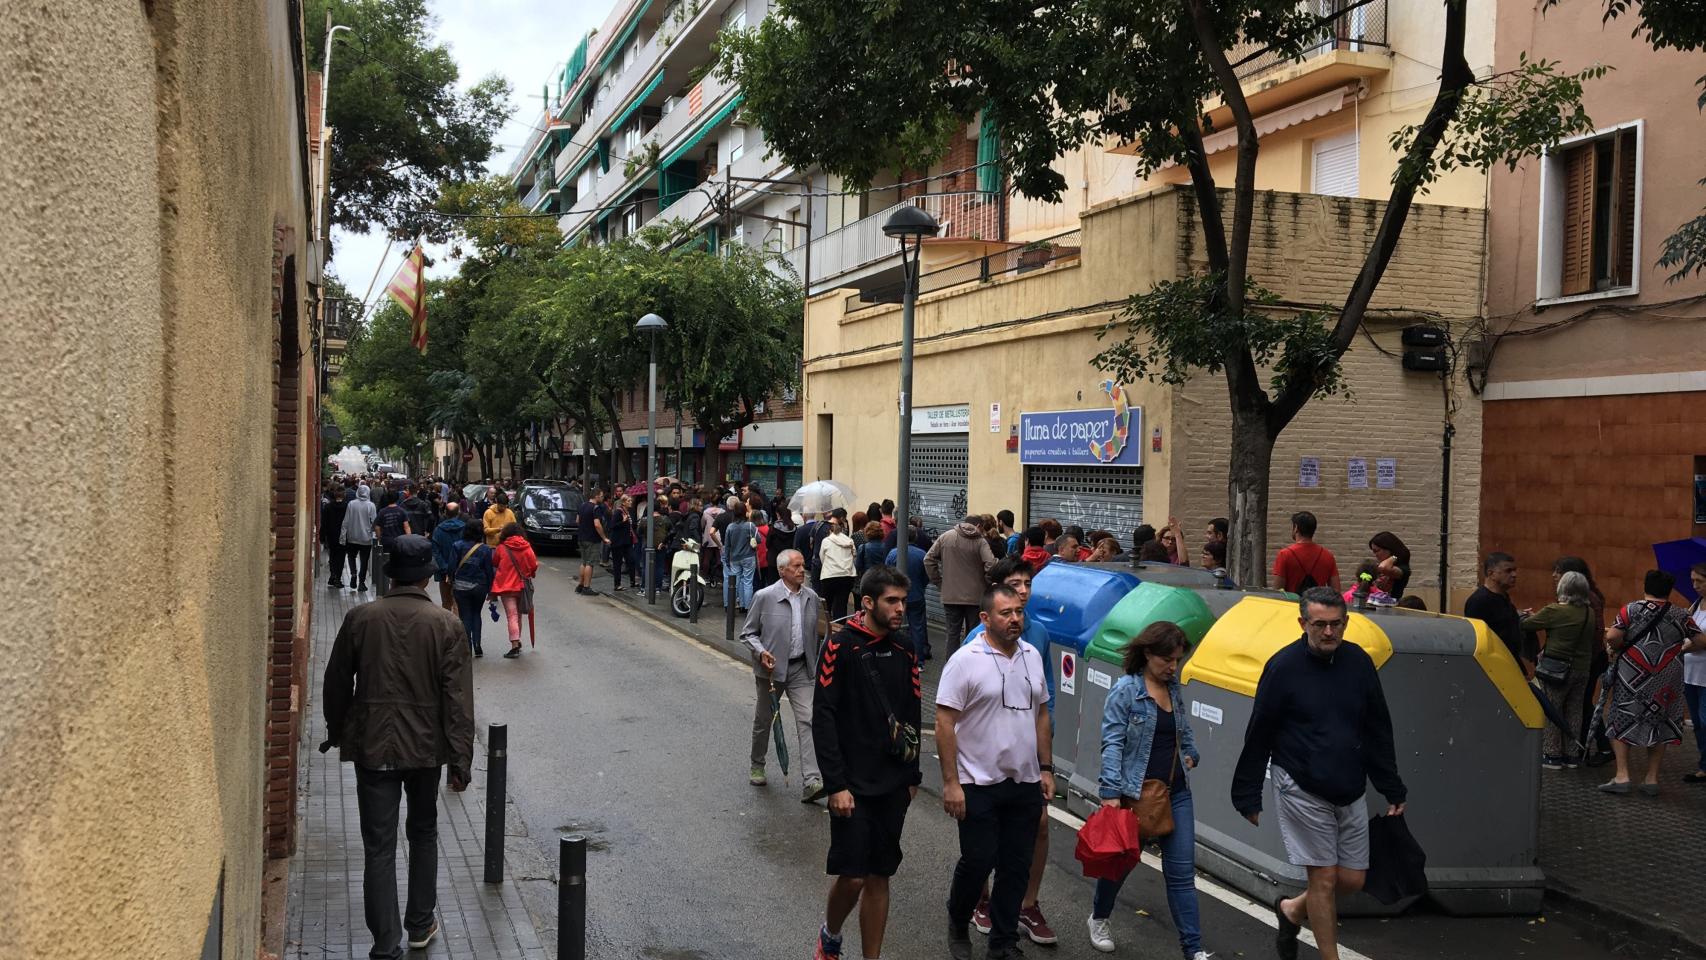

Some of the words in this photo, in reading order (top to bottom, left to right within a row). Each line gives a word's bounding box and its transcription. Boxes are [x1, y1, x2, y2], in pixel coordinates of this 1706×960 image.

[1077, 390, 1082, 402] 6
[1024, 417, 1050, 441] lluna
[1051, 415, 1068, 440] de
[1069, 420, 1109, 444] paper
